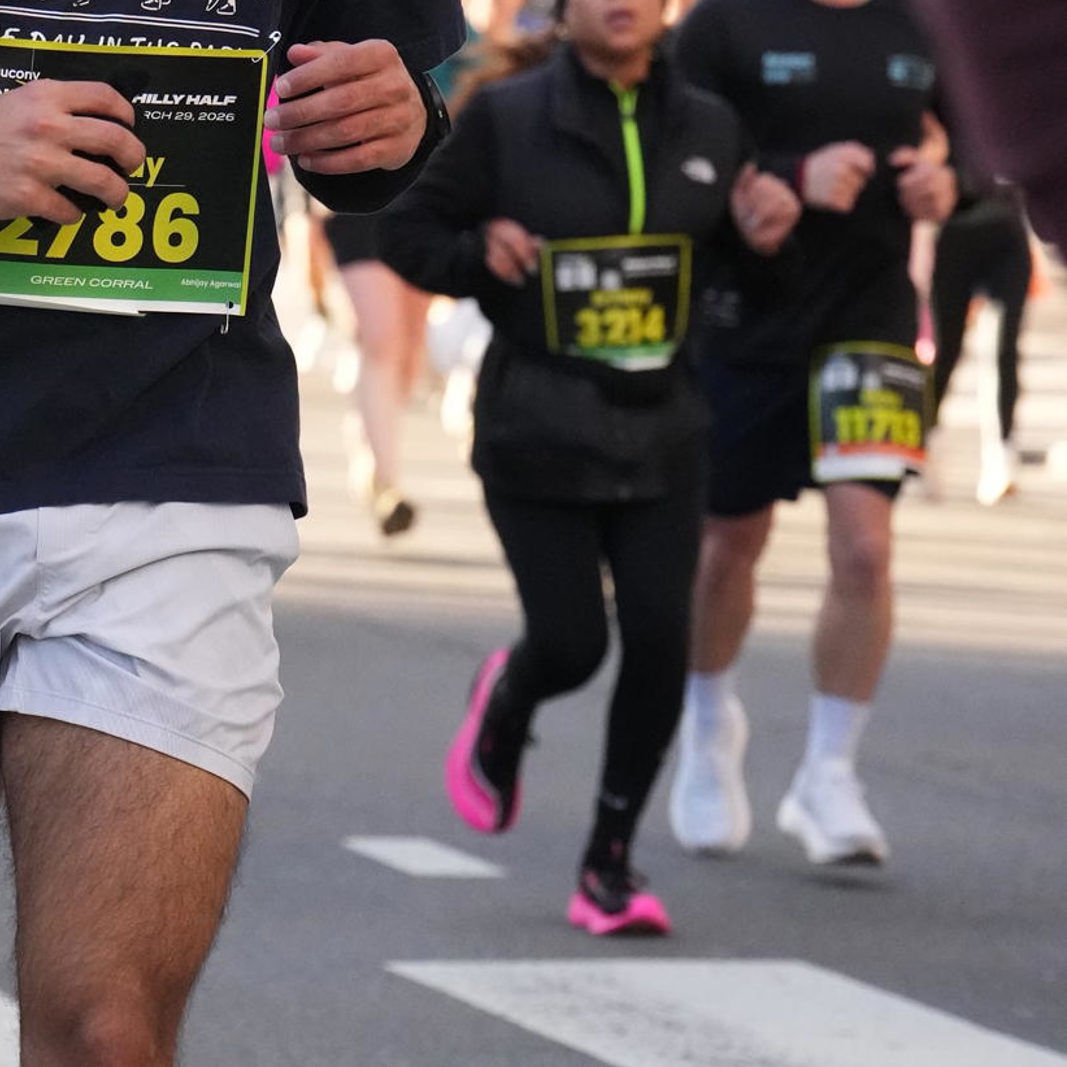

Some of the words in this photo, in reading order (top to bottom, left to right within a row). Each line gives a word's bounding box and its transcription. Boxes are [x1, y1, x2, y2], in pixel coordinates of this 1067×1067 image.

[131, 93, 185, 105] HILLY
[185, 94, 237, 106] HALF
[143, 110, 173, 121] RCH
[174, 111, 195, 123] 29,
[197, 111, 236, 122] 2026
[29, 274, 87, 288] GREEN
[89, 277, 154, 291] CORRAL
